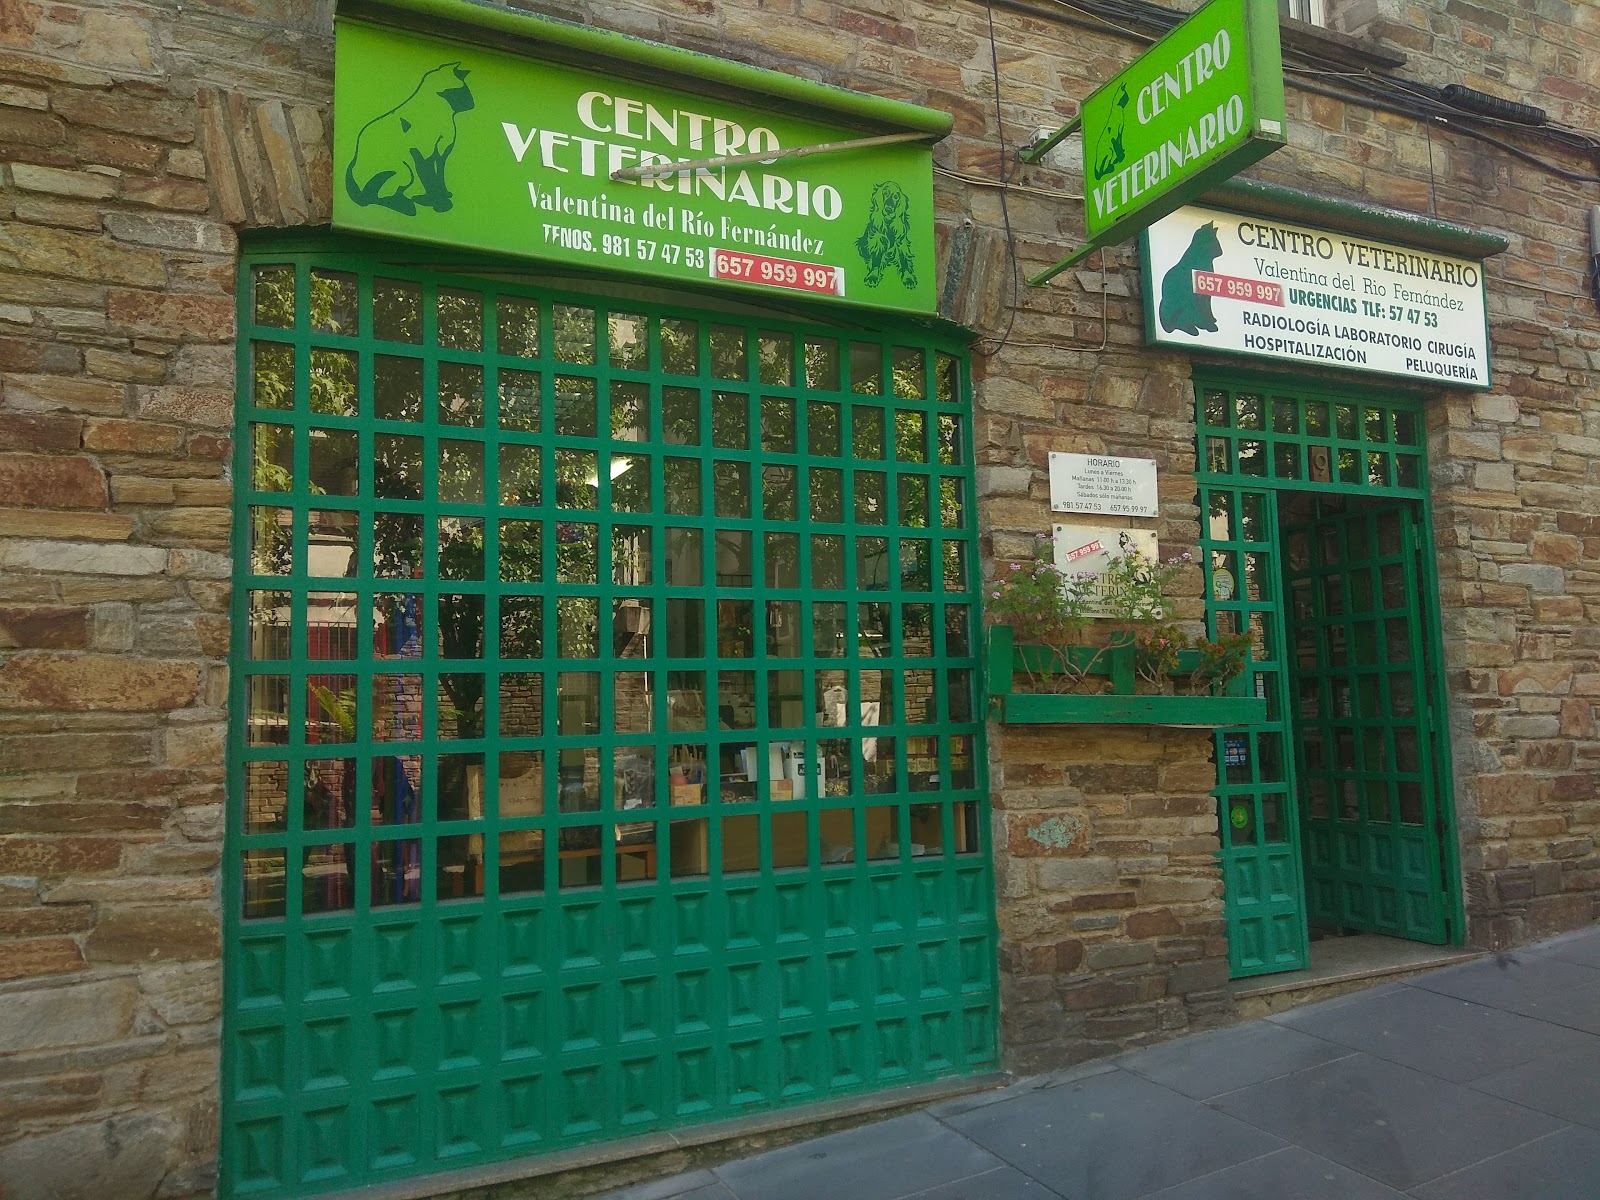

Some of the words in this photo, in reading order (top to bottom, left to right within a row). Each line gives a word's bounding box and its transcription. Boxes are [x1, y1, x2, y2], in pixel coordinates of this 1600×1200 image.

[1136, 28, 1231, 125] CENTRO
[576, 91, 780, 165] CENTRO
[501, 121, 843, 221] VETERINARIO
[1092, 94, 1244, 219] VETERINARIO
[528, 182, 636, 225] Valentina
[642, 203, 674, 231] del
[681, 209, 715, 238] Río
[721, 216, 824, 256] Fernández
[602, 233, 630, 258] 981
[637, 239, 657, 261] 57
[661, 244, 681, 265] 47
[685, 247, 704, 269] 53
[717, 254, 754, 277] 657
[760, 261, 797, 283] 959
[803, 267, 836, 290] 997
[1237, 222, 1333, 260] CENTRO
[1341, 241, 1478, 288] VETERINARIO
[1197, 275, 1223, 293] 657
[1227, 280, 1253, 298] 959
[1256, 285, 1281, 302] 997
[1254, 257, 1328, 287] Valentina
[1332, 272, 1355, 292] del
[1393, 282, 1464, 312] Fernández
[1288, 288, 1358, 314] URGENCIAS
[1362, 300, 1386, 319] TLF:
[1389, 305, 1404, 321] 57
[1407, 308, 1421, 325] 47
[1424, 311, 1438, 328] 53
[1242, 311, 1331, 337] RADIOLOGÍA
[1334, 325, 1422, 351] LABORATORIO
[1428, 340, 1477, 360] CIRUGÍA
[1244, 333, 1367, 364] HOSPITALIZACIÓN
[1406, 357, 1478, 381] PELUQUERÍA
[1087, 458, 1120, 468] HORARIO
[1105, 469, 1124, 477] Viernes
[1062, 501, 1074, 509] 981
[1084, 502, 1093, 510] 47
[1093, 503, 1102, 511] 53
[1109, 504, 1121, 512] 657
[1131, 505, 1139, 513] 99
[1079, 545, 1091, 556] 959
